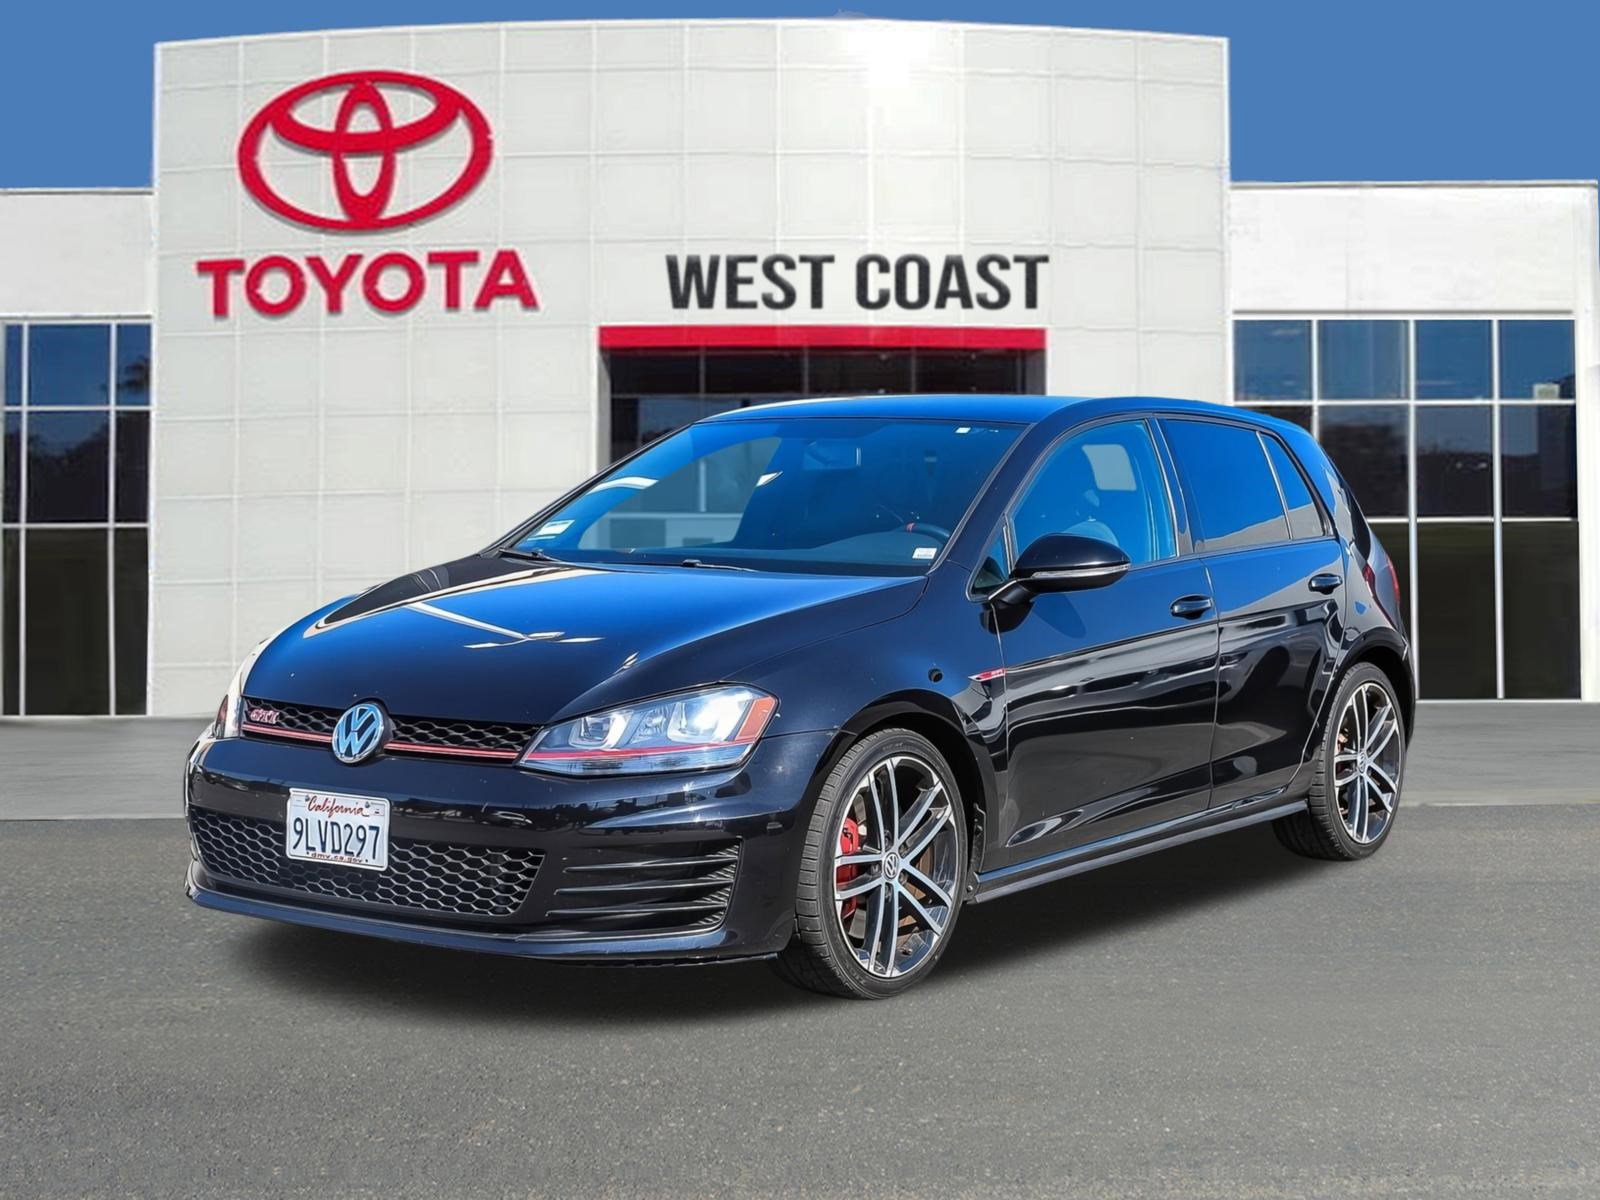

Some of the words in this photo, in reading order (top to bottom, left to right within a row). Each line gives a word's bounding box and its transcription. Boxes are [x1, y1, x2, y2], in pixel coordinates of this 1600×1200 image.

[196, 249, 539, 318] TOYOTA
[666, 254, 835, 310] WEST
[855, 254, 1050, 310] COAST
[307, 795, 370, 818] California
[293, 817, 381, 860] 9LVD297
